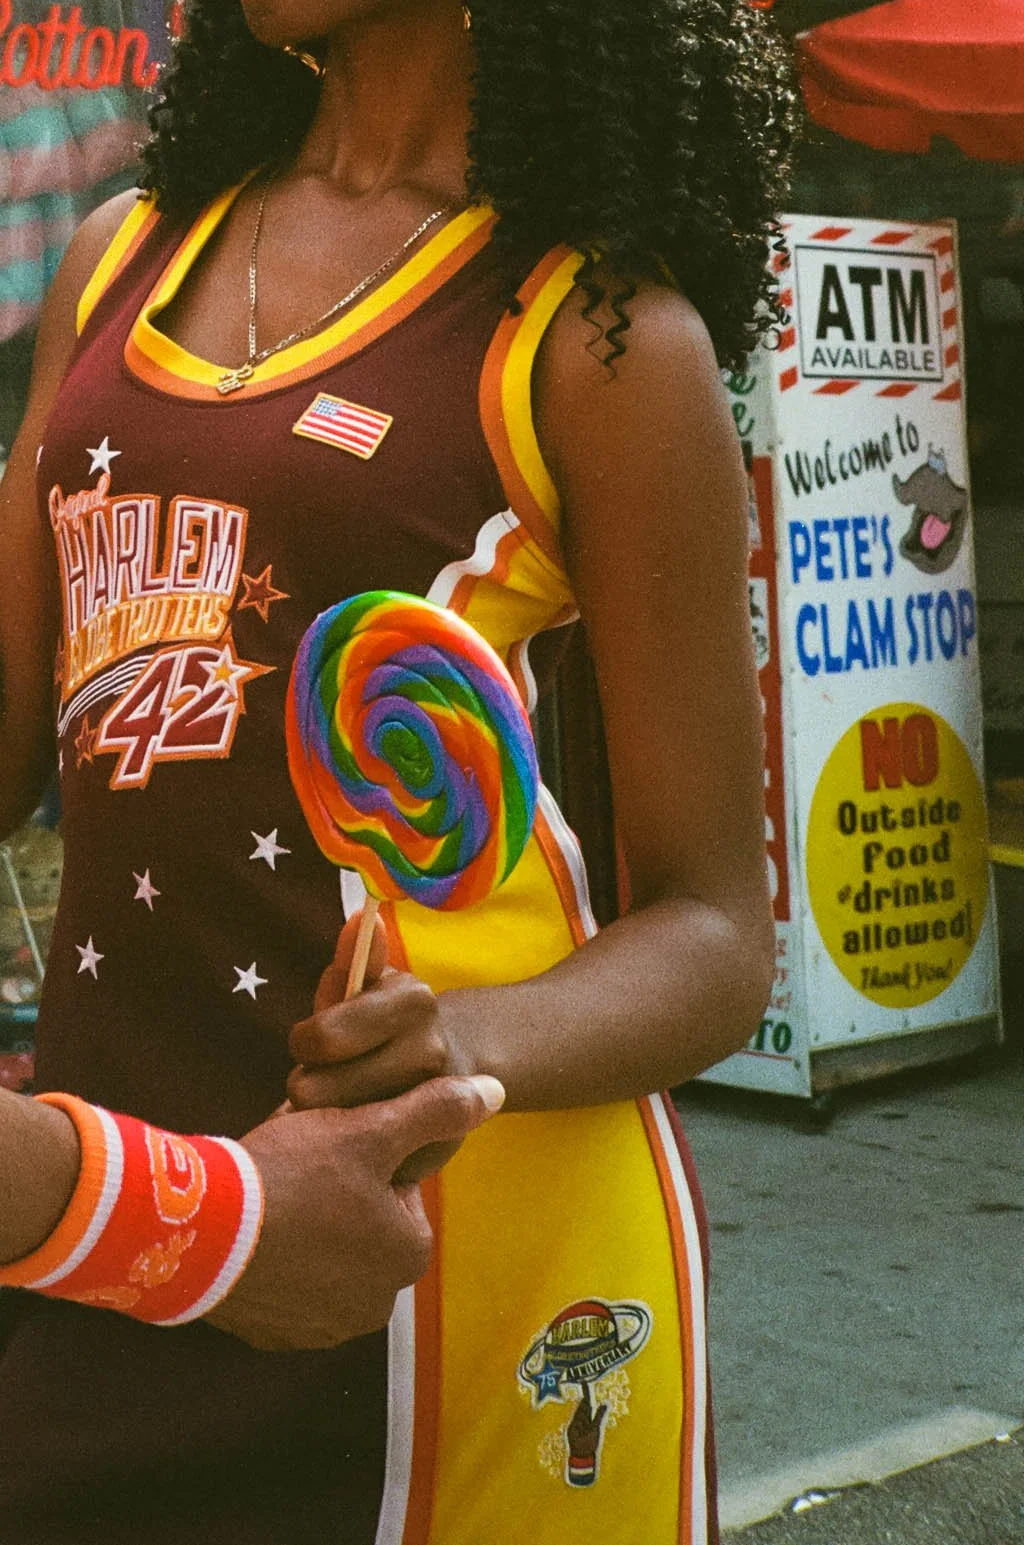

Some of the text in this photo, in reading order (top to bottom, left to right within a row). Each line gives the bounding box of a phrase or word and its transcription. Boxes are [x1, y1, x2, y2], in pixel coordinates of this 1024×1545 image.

[815, 263, 931, 344] ATM
[810, 346, 936, 372] AVAILABLE
[784, 414, 920, 498] Welcome to
[60, 497, 245, 636] HARLEM
[789, 514, 894, 584] PETE'S
[796, 597, 898, 677] CLAM
[905, 588, 974, 666] STOP
[97, 643, 240, 786] 42
[860, 714, 939, 792] NO
[838, 796, 962, 835] Outside
[862, 831, 951, 874] food
[854, 876, 956, 913] drinks
[551, 1318, 610, 1345] HARLEM
[536, 1370, 561, 1390] 75
